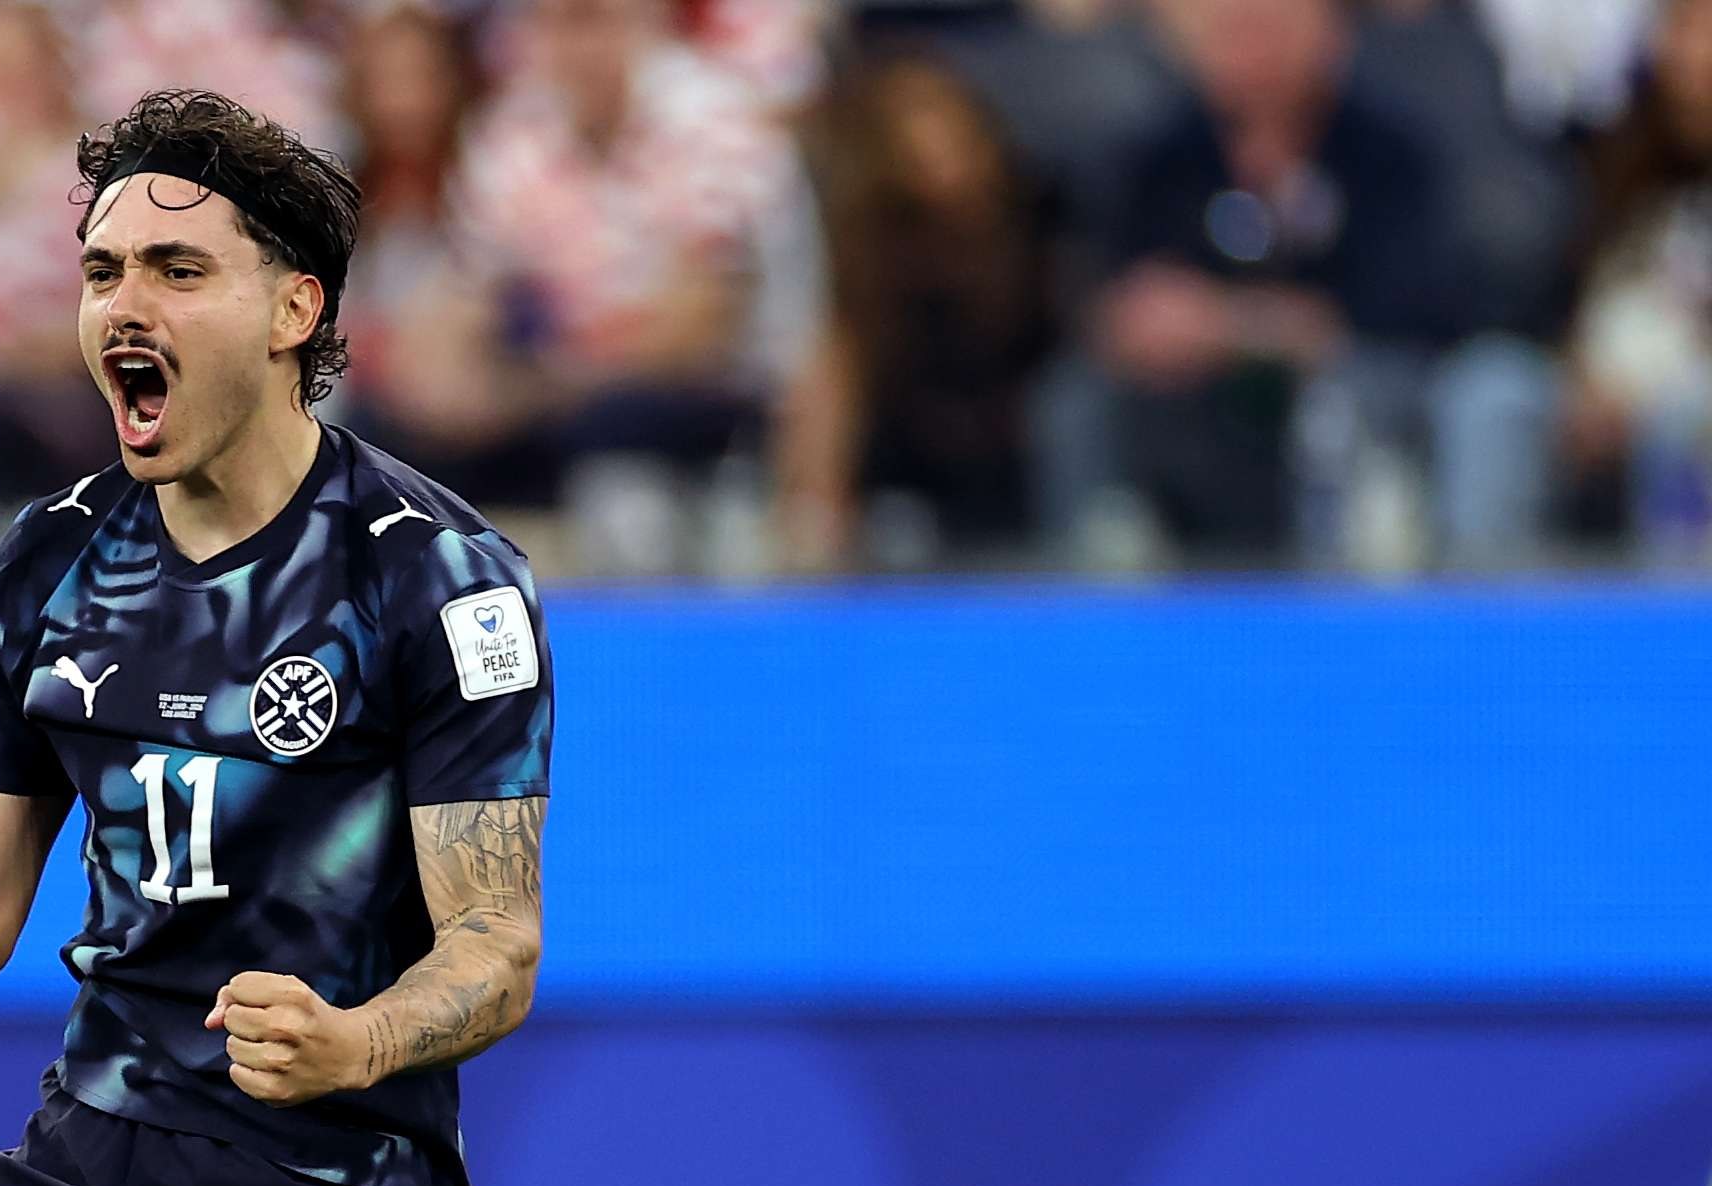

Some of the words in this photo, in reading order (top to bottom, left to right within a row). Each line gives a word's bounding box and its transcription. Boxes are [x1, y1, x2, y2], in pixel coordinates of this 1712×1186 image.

[482, 651, 520, 673] PEACE
[282, 664, 313, 682] APF
[494, 672, 515, 683] FIFA
[131, 753, 229, 905] 11
